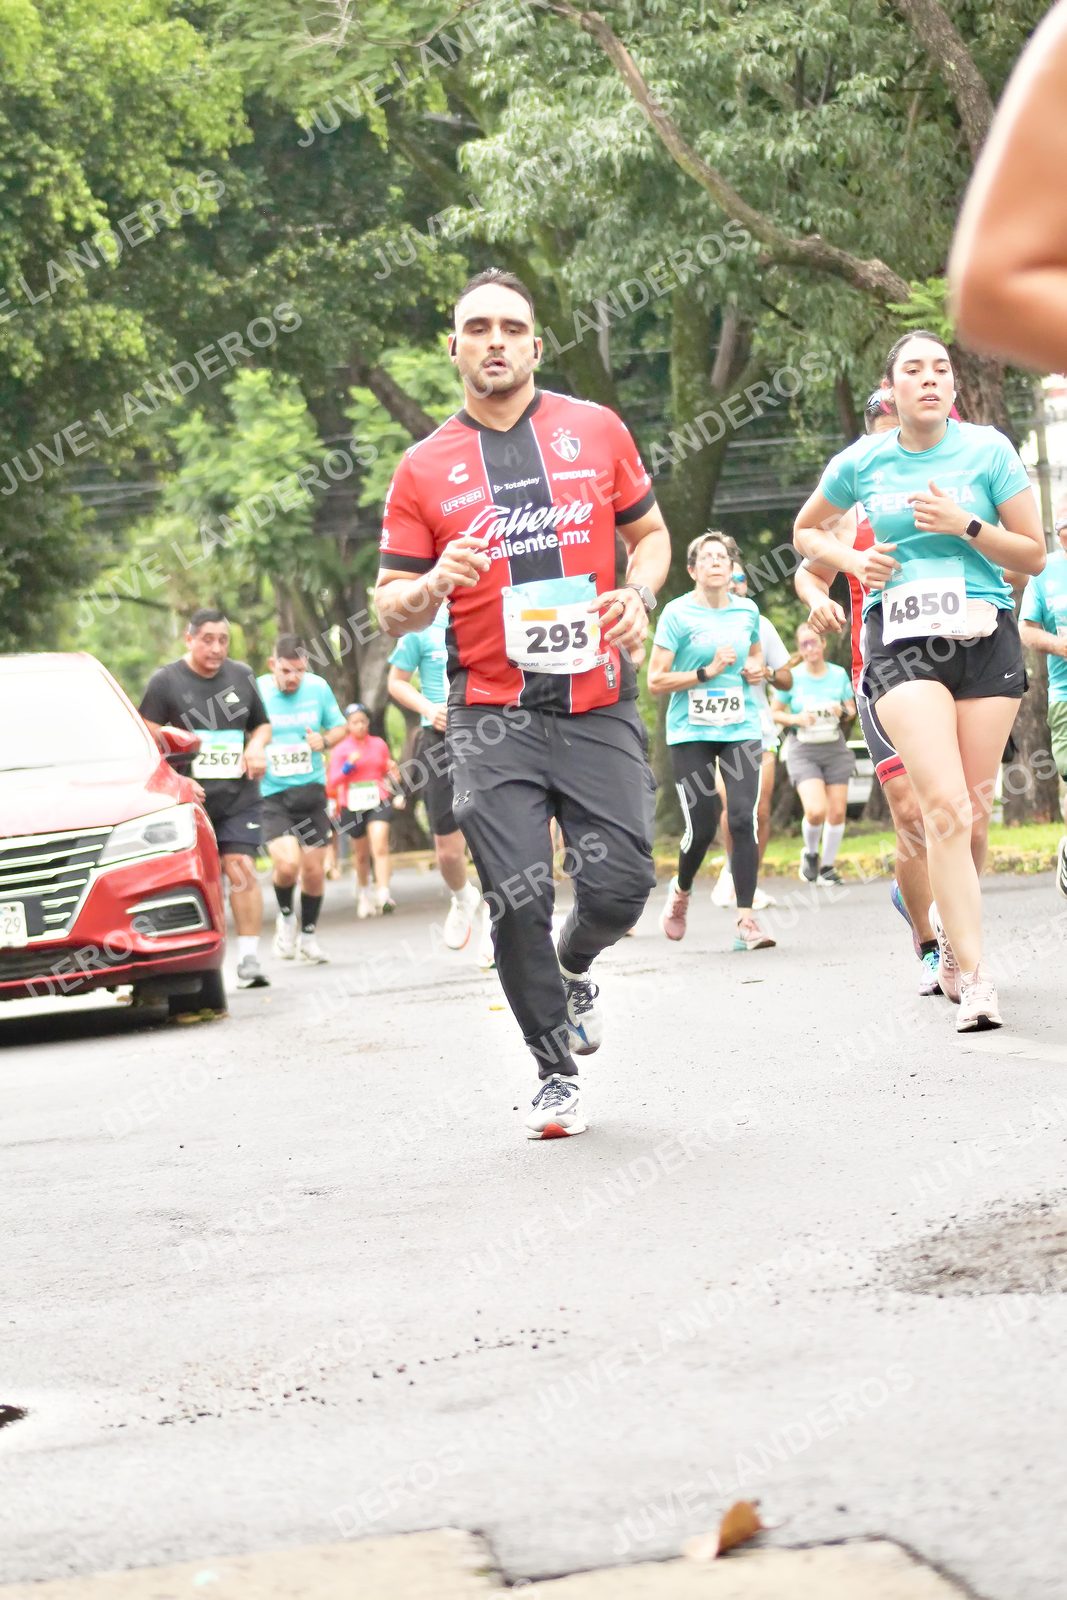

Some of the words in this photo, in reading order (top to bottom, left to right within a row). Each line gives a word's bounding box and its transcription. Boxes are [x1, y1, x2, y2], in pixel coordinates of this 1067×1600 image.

[503, 477, 541, 491] Totalplay
[552, 468, 596, 481] PERDURA
[444, 490, 483, 512] URREA
[869, 484, 976, 512] PERRA
[459, 500, 593, 543] Caliente
[481, 529, 591, 561] caliente.mx
[889, 591, 960, 624] 4850
[525, 620, 588, 654] 293
[692, 697, 740, 714] 3478
[199, 752, 241, 766] 2567
[272, 752, 309, 766] 3382
